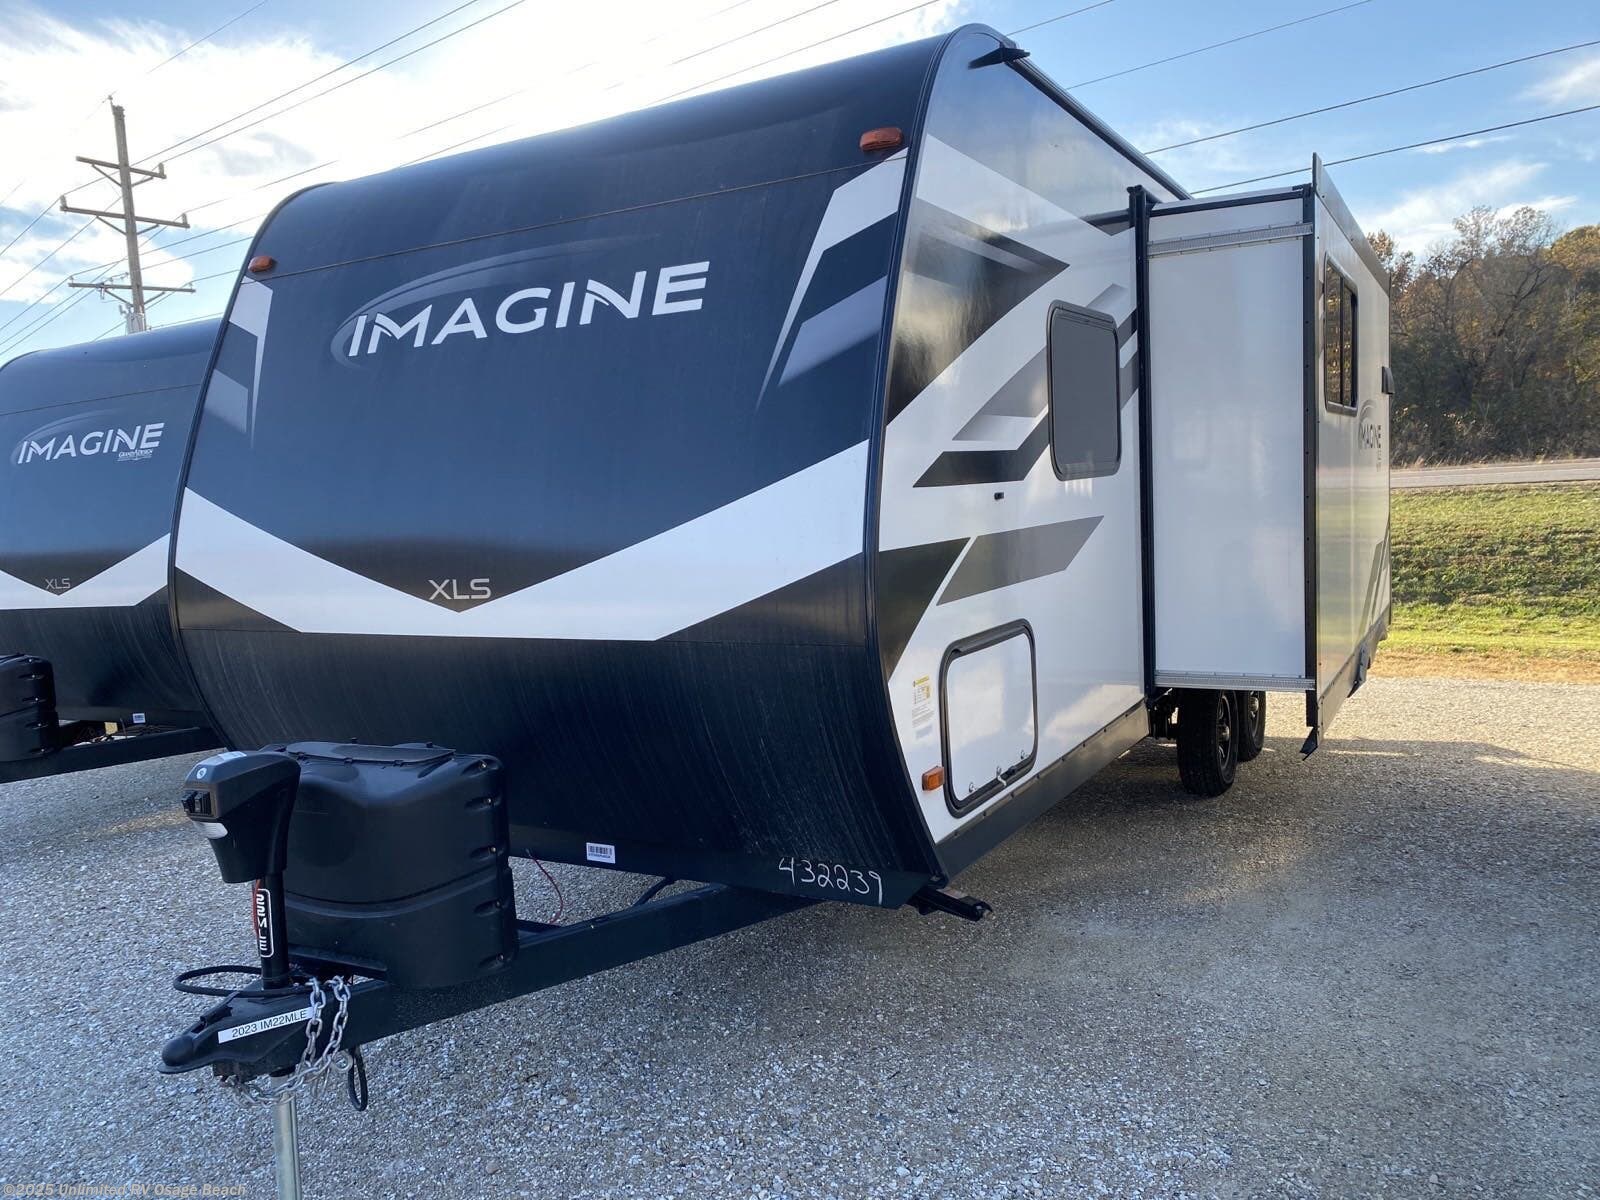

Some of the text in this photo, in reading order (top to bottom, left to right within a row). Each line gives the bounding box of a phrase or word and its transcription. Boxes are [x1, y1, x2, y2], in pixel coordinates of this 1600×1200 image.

[348, 261, 710, 357] IMAGINE
[17, 422, 165, 464] IMAGINE
[45, 578, 71, 589] XLS
[428, 578, 492, 600] XLS
[778, 856, 883, 905] 432239
[231, 1008, 307, 1038] 2023 IM22MLE
